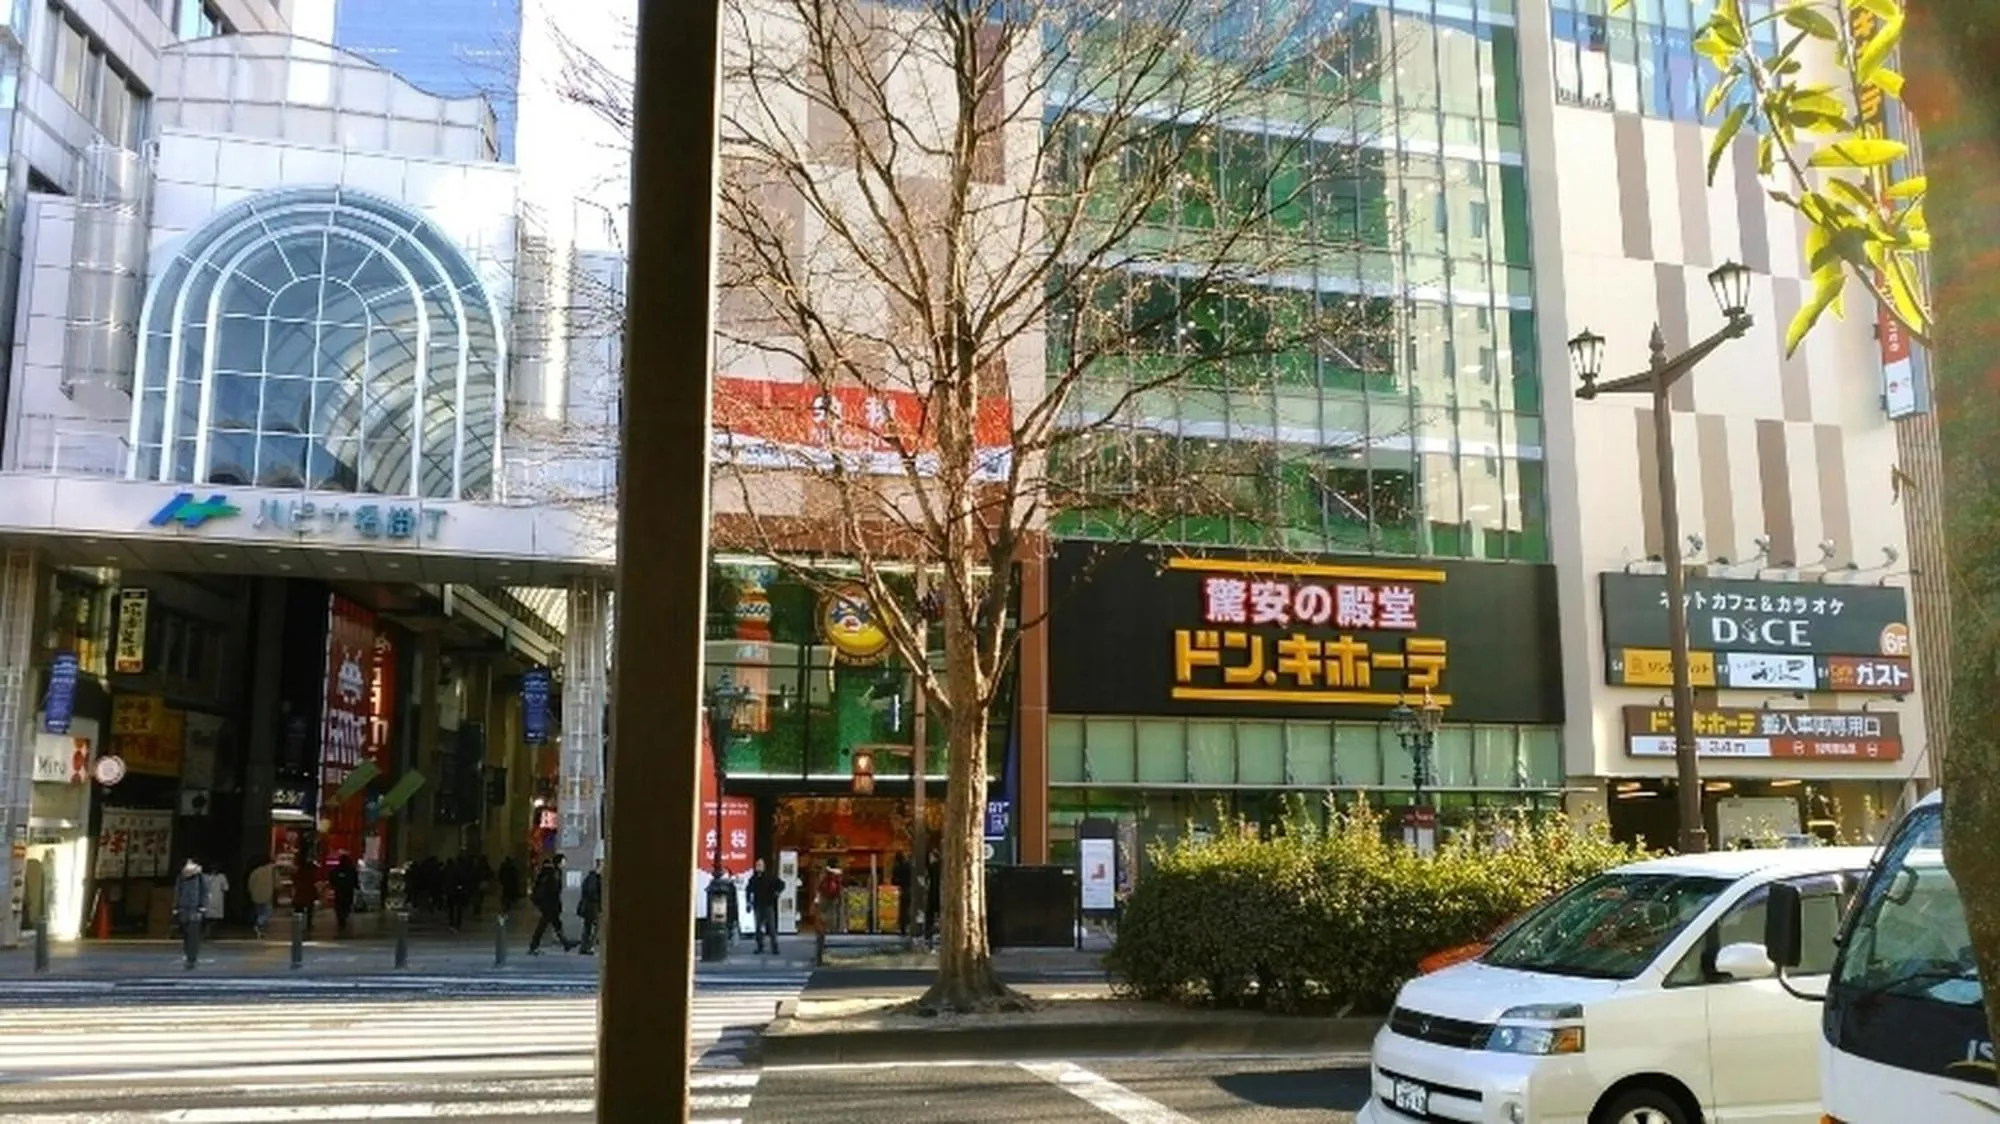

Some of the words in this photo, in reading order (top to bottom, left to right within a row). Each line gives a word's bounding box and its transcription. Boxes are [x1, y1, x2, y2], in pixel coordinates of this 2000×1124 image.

[1205, 577, 1418, 629] 驚安の殿堂
[1711, 616, 1812, 647] DICE
[1856, 662, 1908, 686] ガスト
